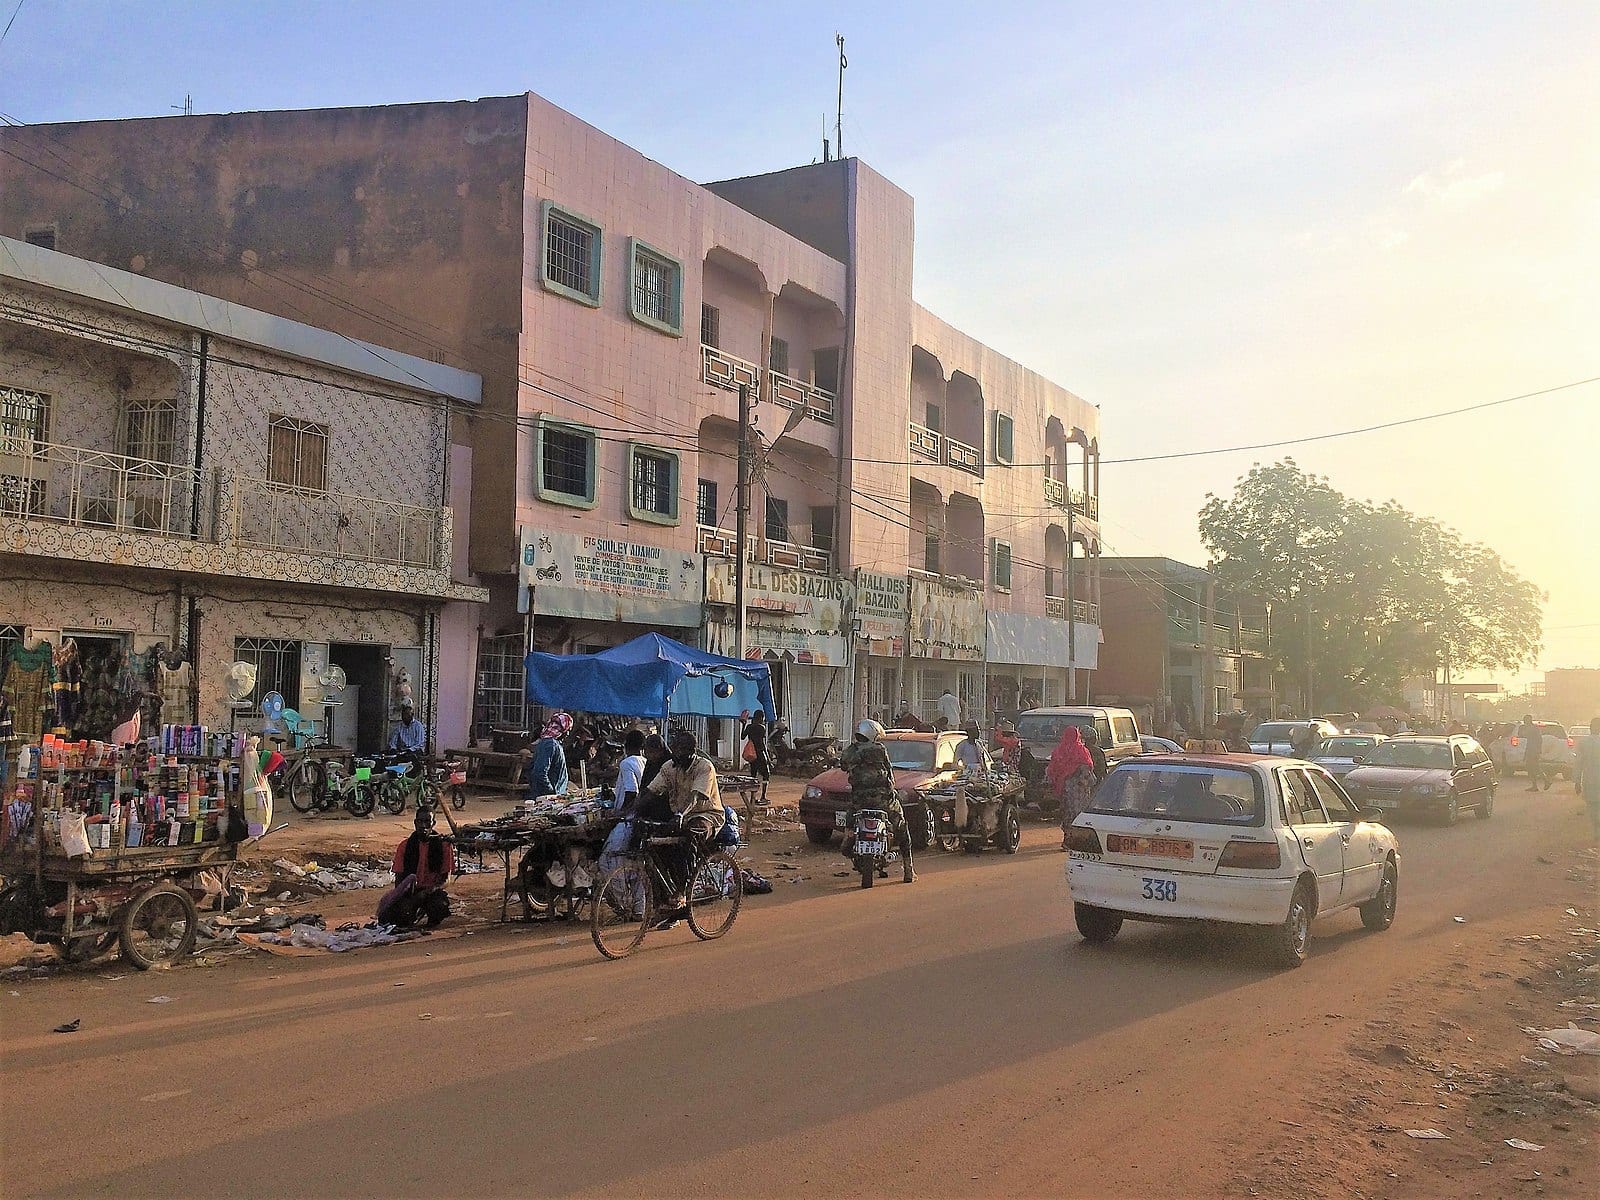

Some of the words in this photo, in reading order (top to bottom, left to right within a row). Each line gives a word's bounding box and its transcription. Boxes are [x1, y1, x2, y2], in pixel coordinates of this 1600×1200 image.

[597, 538, 628, 555] SOULEY
[574, 555, 591, 564] VENTE
[592, 558, 600, 566] DE
[602, 559, 621, 569] MOTOS
[622, 562, 642, 572] TOUTES
[643, 566, 668, 576] MARQUES
[658, 575, 669, 584] ETC
[860, 573, 885, 592] HALL
[887, 578, 905, 594] DES
[865, 591, 899, 610] BAZINS
[1141, 877, 1178, 903] 338
